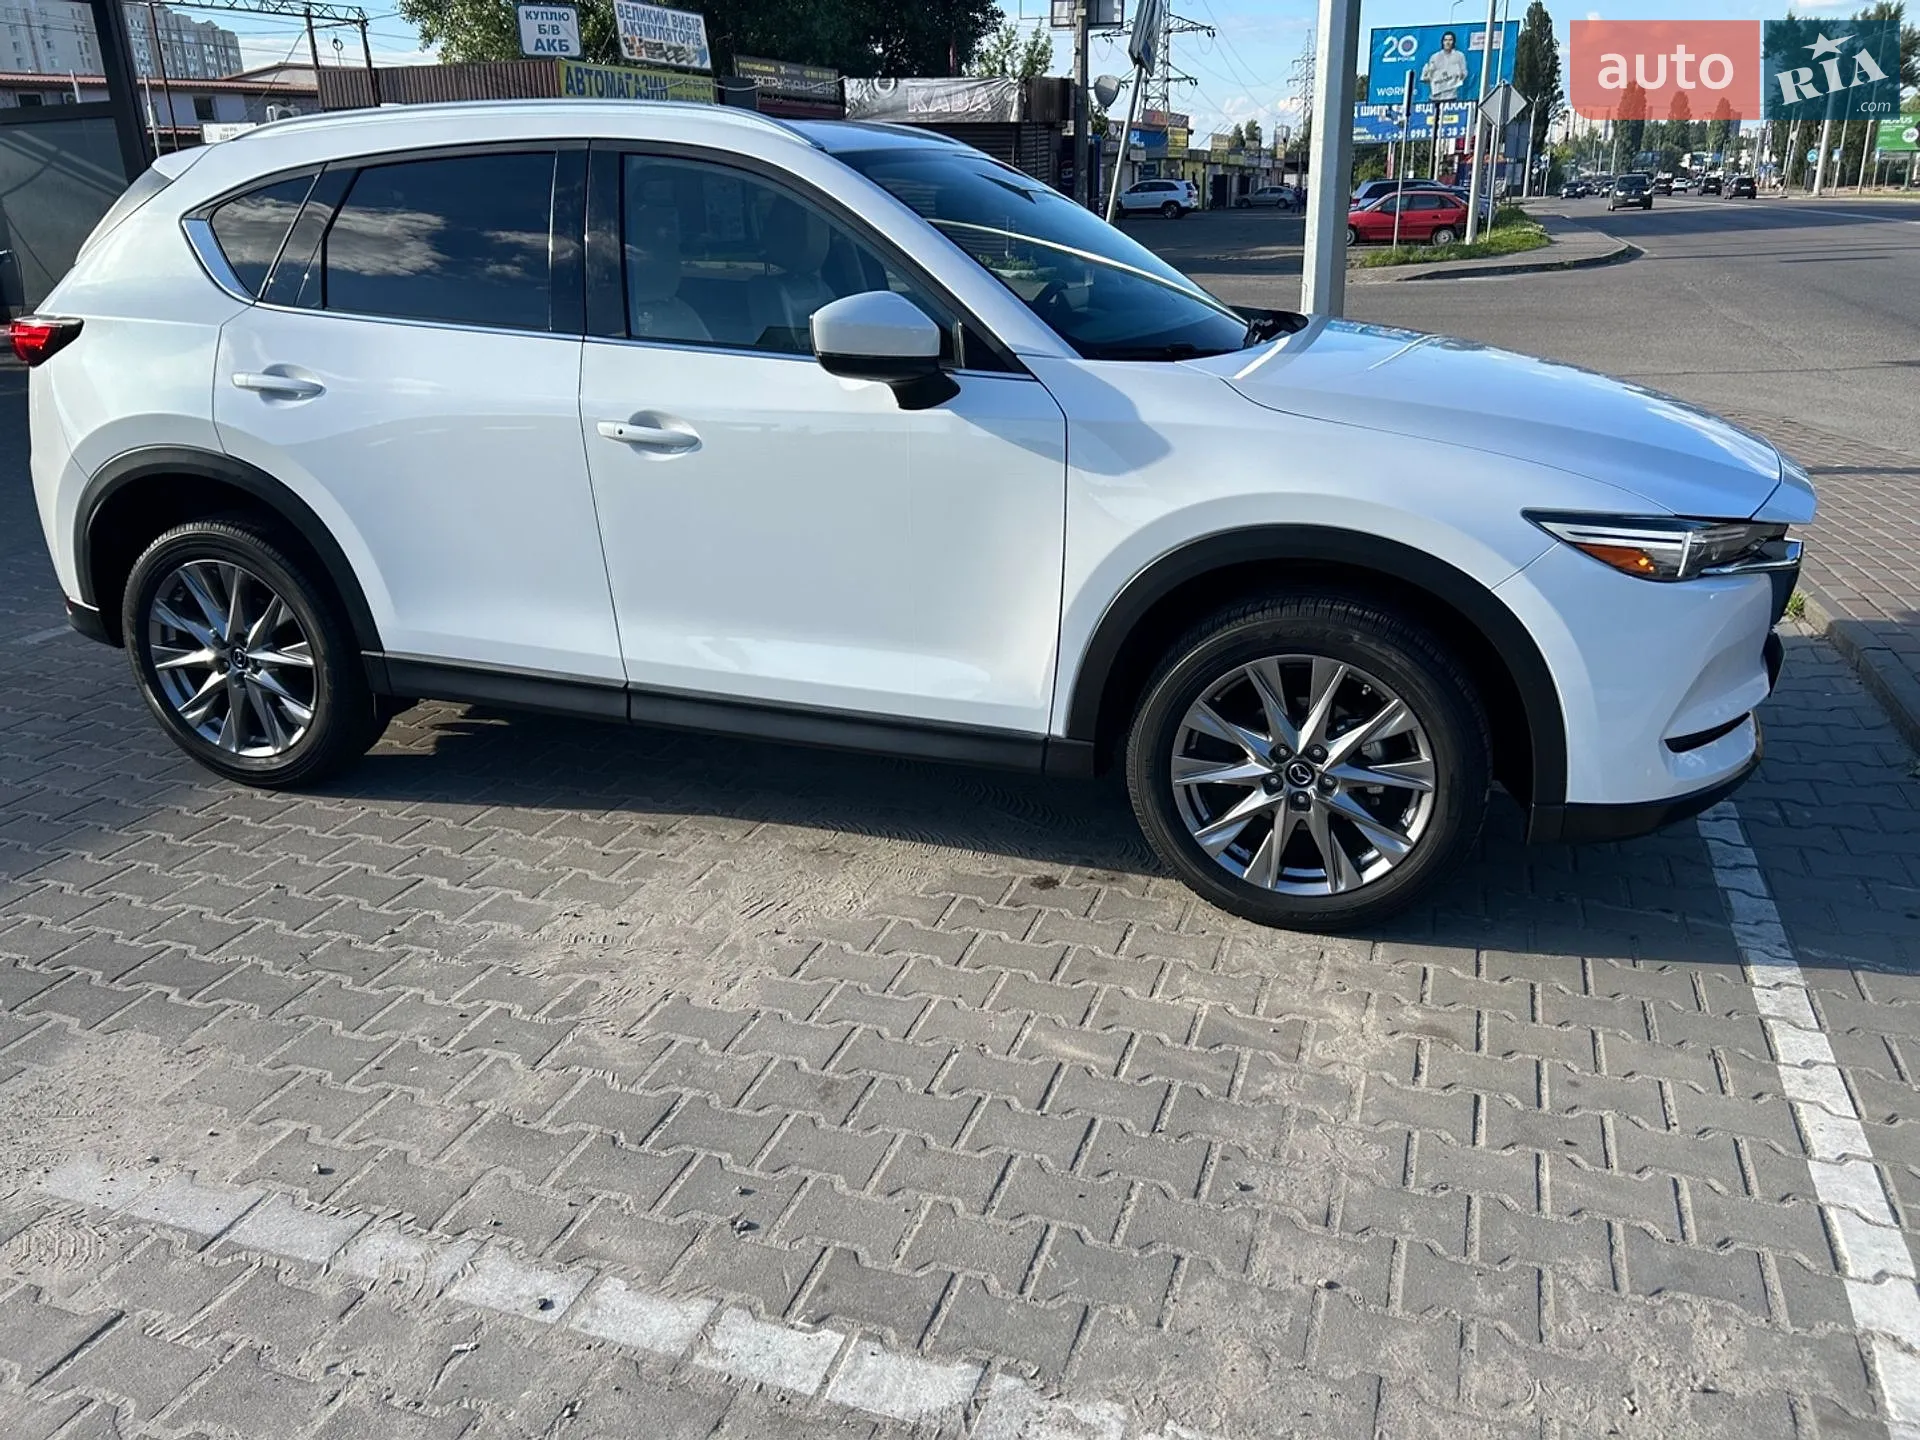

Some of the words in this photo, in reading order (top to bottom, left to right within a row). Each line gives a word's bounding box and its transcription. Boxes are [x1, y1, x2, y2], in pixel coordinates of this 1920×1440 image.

[525, 10, 570, 21] КУПЛЮ
[617, 4, 669, 25] ВЕЛИКИЙ
[672, 14, 702, 31] ВИБІР
[537, 24, 560, 35] Б/В
[623, 20, 702, 46] АКУМУЛЯТОРІВ
[534, 38, 570, 52] АКБ
[1383, 35, 1418, 58] 20
[565, 65, 668, 100] АВТОМАГАЗИН
